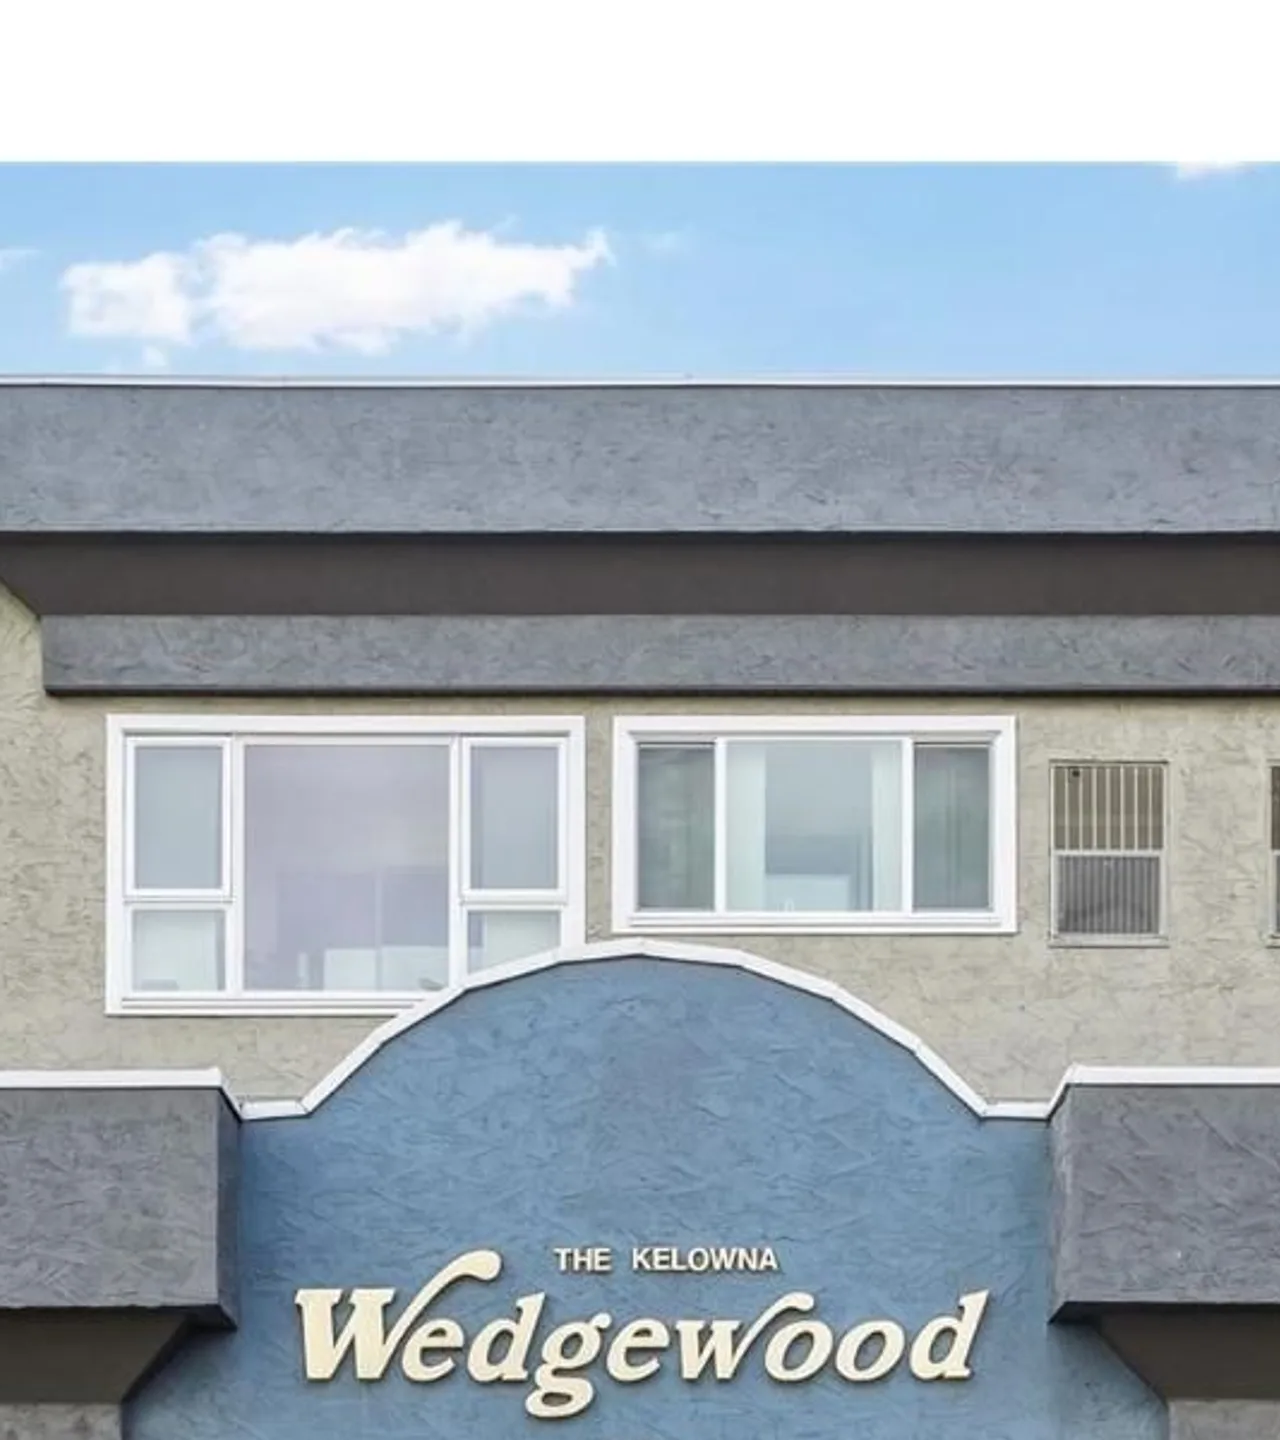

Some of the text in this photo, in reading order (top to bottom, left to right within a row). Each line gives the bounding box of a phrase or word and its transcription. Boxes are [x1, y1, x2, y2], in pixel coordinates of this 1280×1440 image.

[554, 1247, 779, 1272] THE KELOWNA
[294, 1250, 990, 1419] Wedgewood
